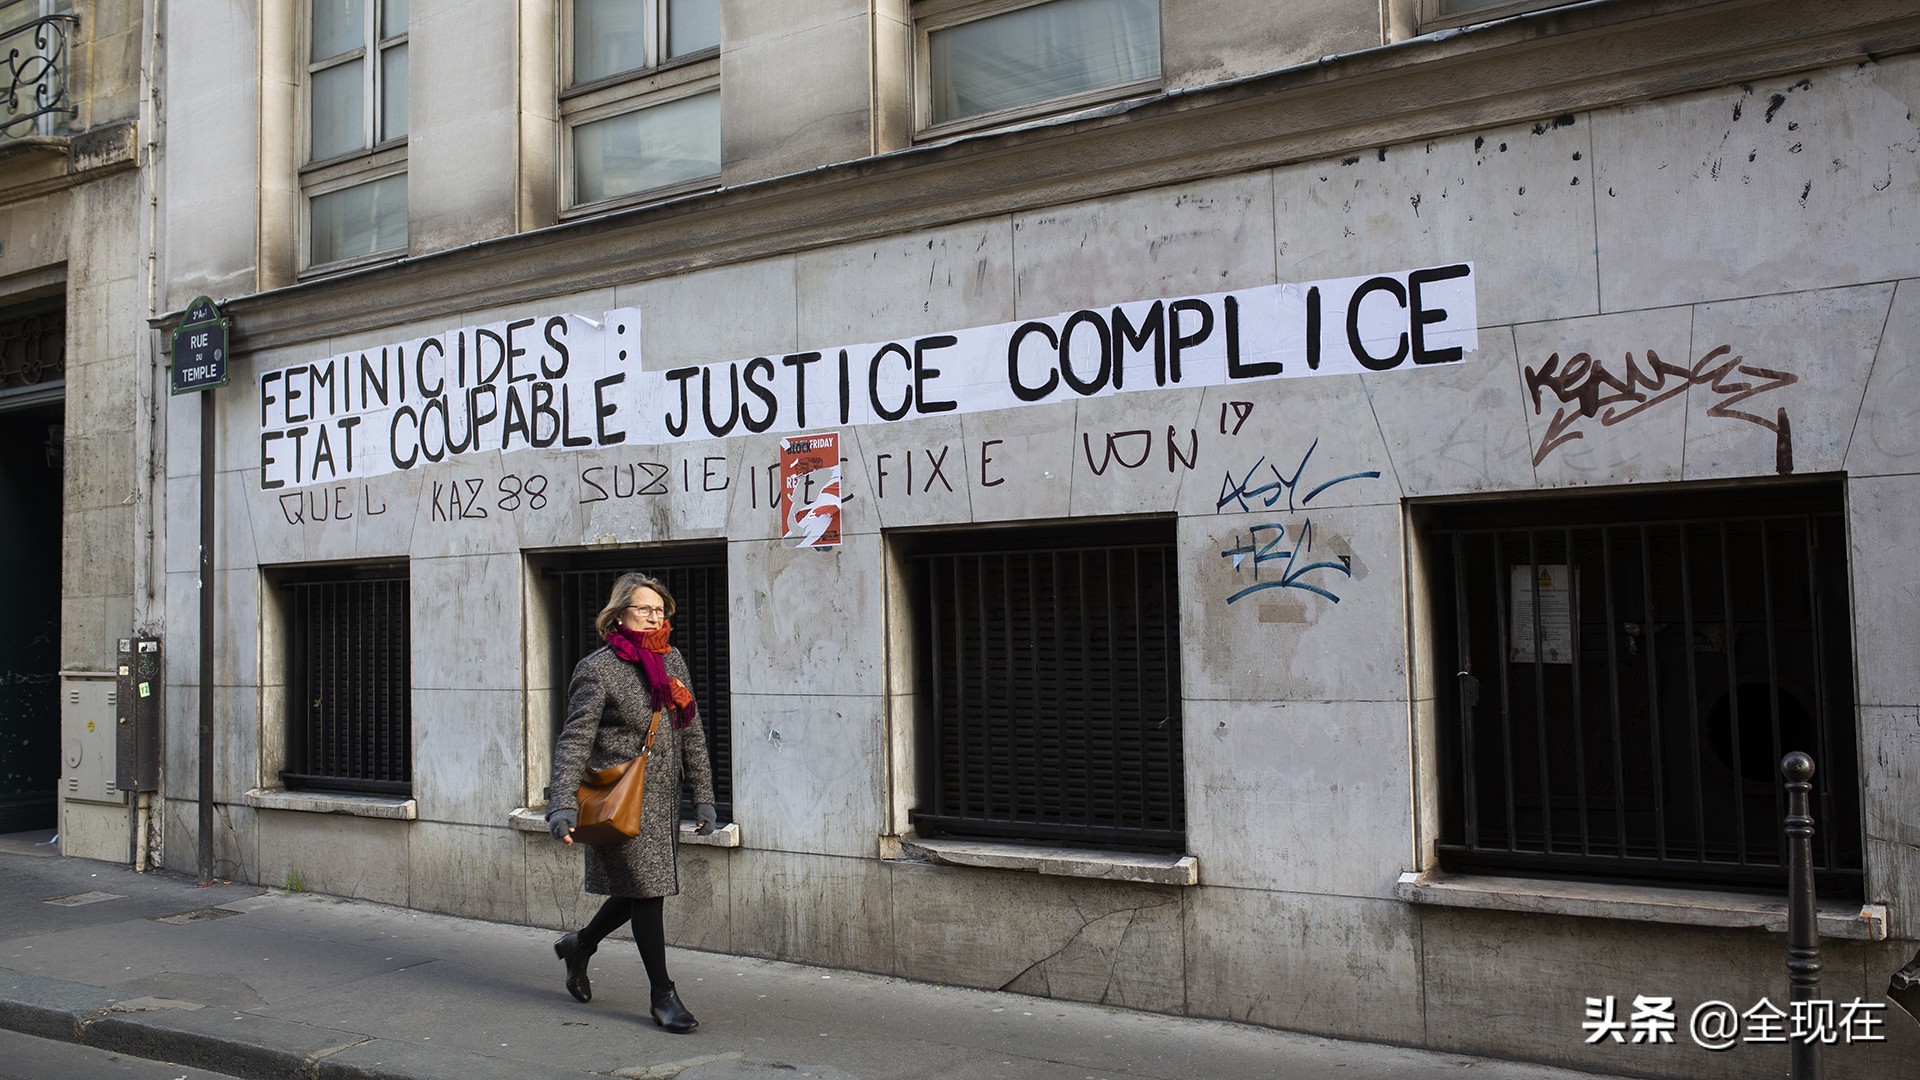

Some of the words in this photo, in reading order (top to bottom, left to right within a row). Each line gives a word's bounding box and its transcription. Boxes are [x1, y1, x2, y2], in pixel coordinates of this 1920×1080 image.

[190, 333, 208, 350] RUE
[195, 353, 203, 361] DU
[182, 363, 217, 383] TEMPLE
[261, 316, 569, 427] FEMINICIDES
[261, 416, 361, 490] ETAT
[390, 372, 627, 470] COUPABLE
[665, 335, 958, 438] JUSTICE
[1007, 264, 1471, 401] COMPLICE
[809, 437, 834, 450] FRIDAY
[497, 474, 549, 511] 88
